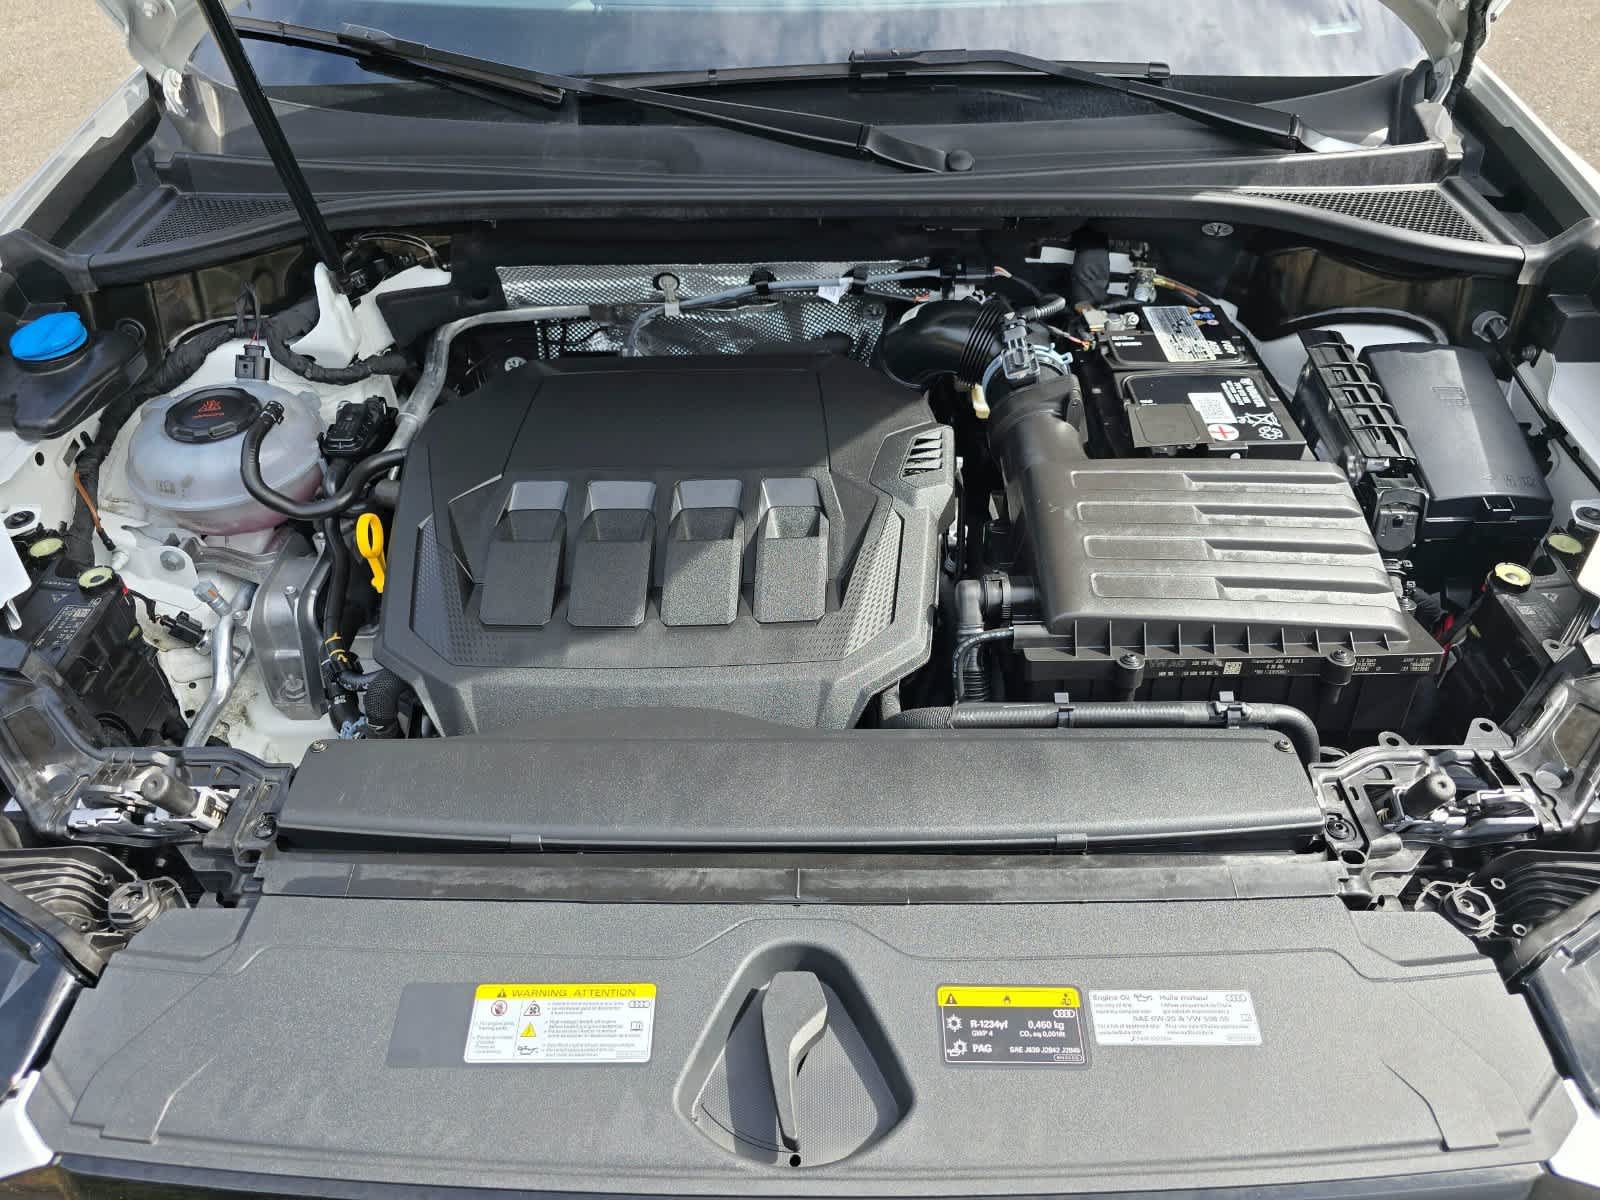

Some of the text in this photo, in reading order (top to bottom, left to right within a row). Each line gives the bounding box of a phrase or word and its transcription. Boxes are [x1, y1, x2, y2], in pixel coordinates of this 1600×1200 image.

[512, 988, 636, 997] WARNING ATTENTION
[1093, 994, 1118, 1002] Engine
[970, 1019, 1009, 1030] R-1234yf
[1053, 1019, 1065, 1030] kg
[972, 1043, 993, 1053] PAG
